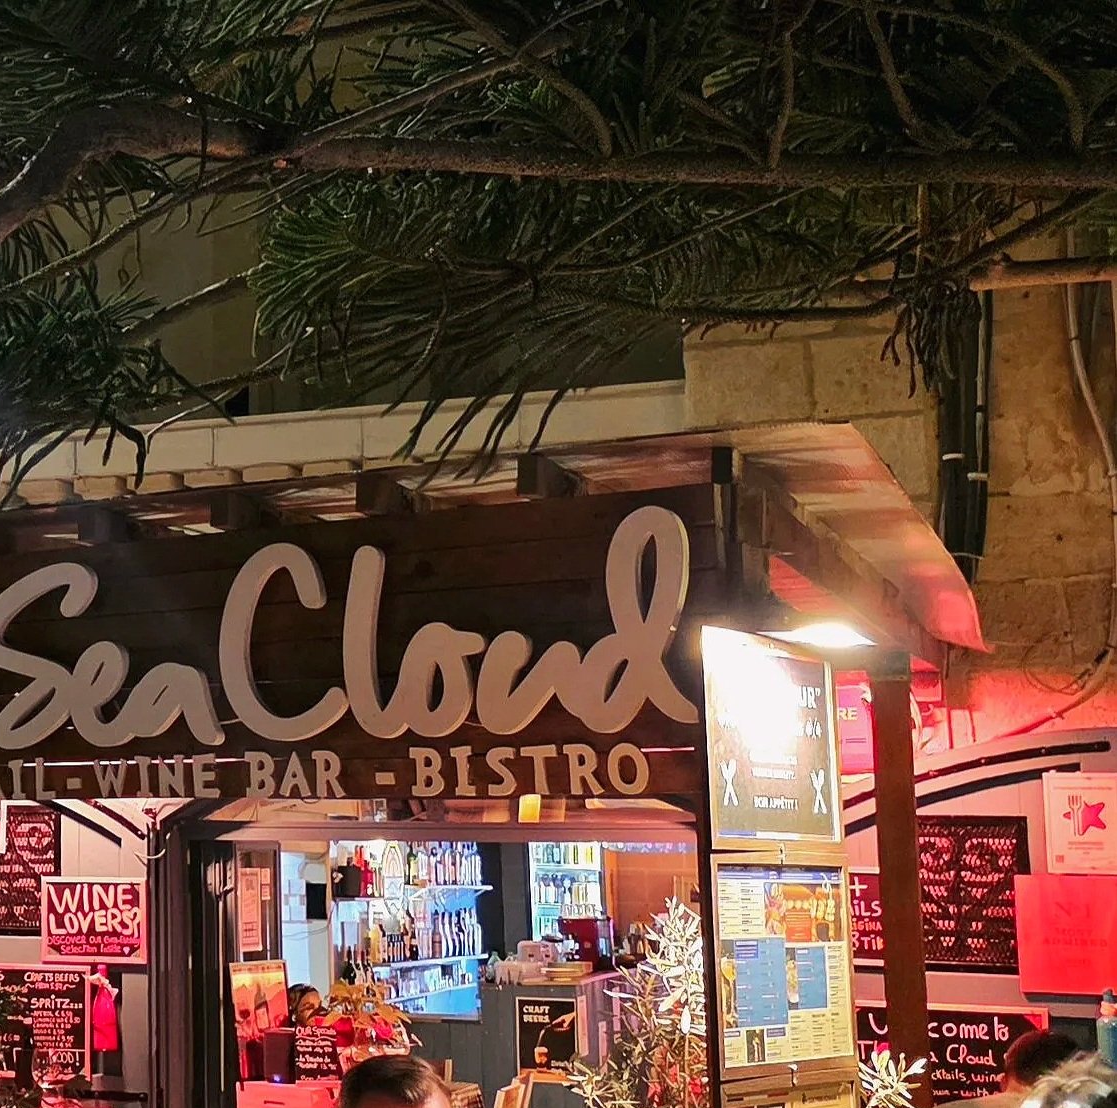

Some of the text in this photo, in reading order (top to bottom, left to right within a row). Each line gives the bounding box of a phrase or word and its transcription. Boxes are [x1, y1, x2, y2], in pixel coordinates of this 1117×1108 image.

[218, 506, 698, 742] Cloud
[93, 753, 220, 799] WINE
[244, 750, 347, 800] BAR
[409, 742, 649, 798] BISTRO
[48, 883, 133, 914] WINE
[523, 1005, 550, 1014] CRAFT
[994, 1016, 1010, 1041] to
[946, 1043, 997, 1067] Cloud
